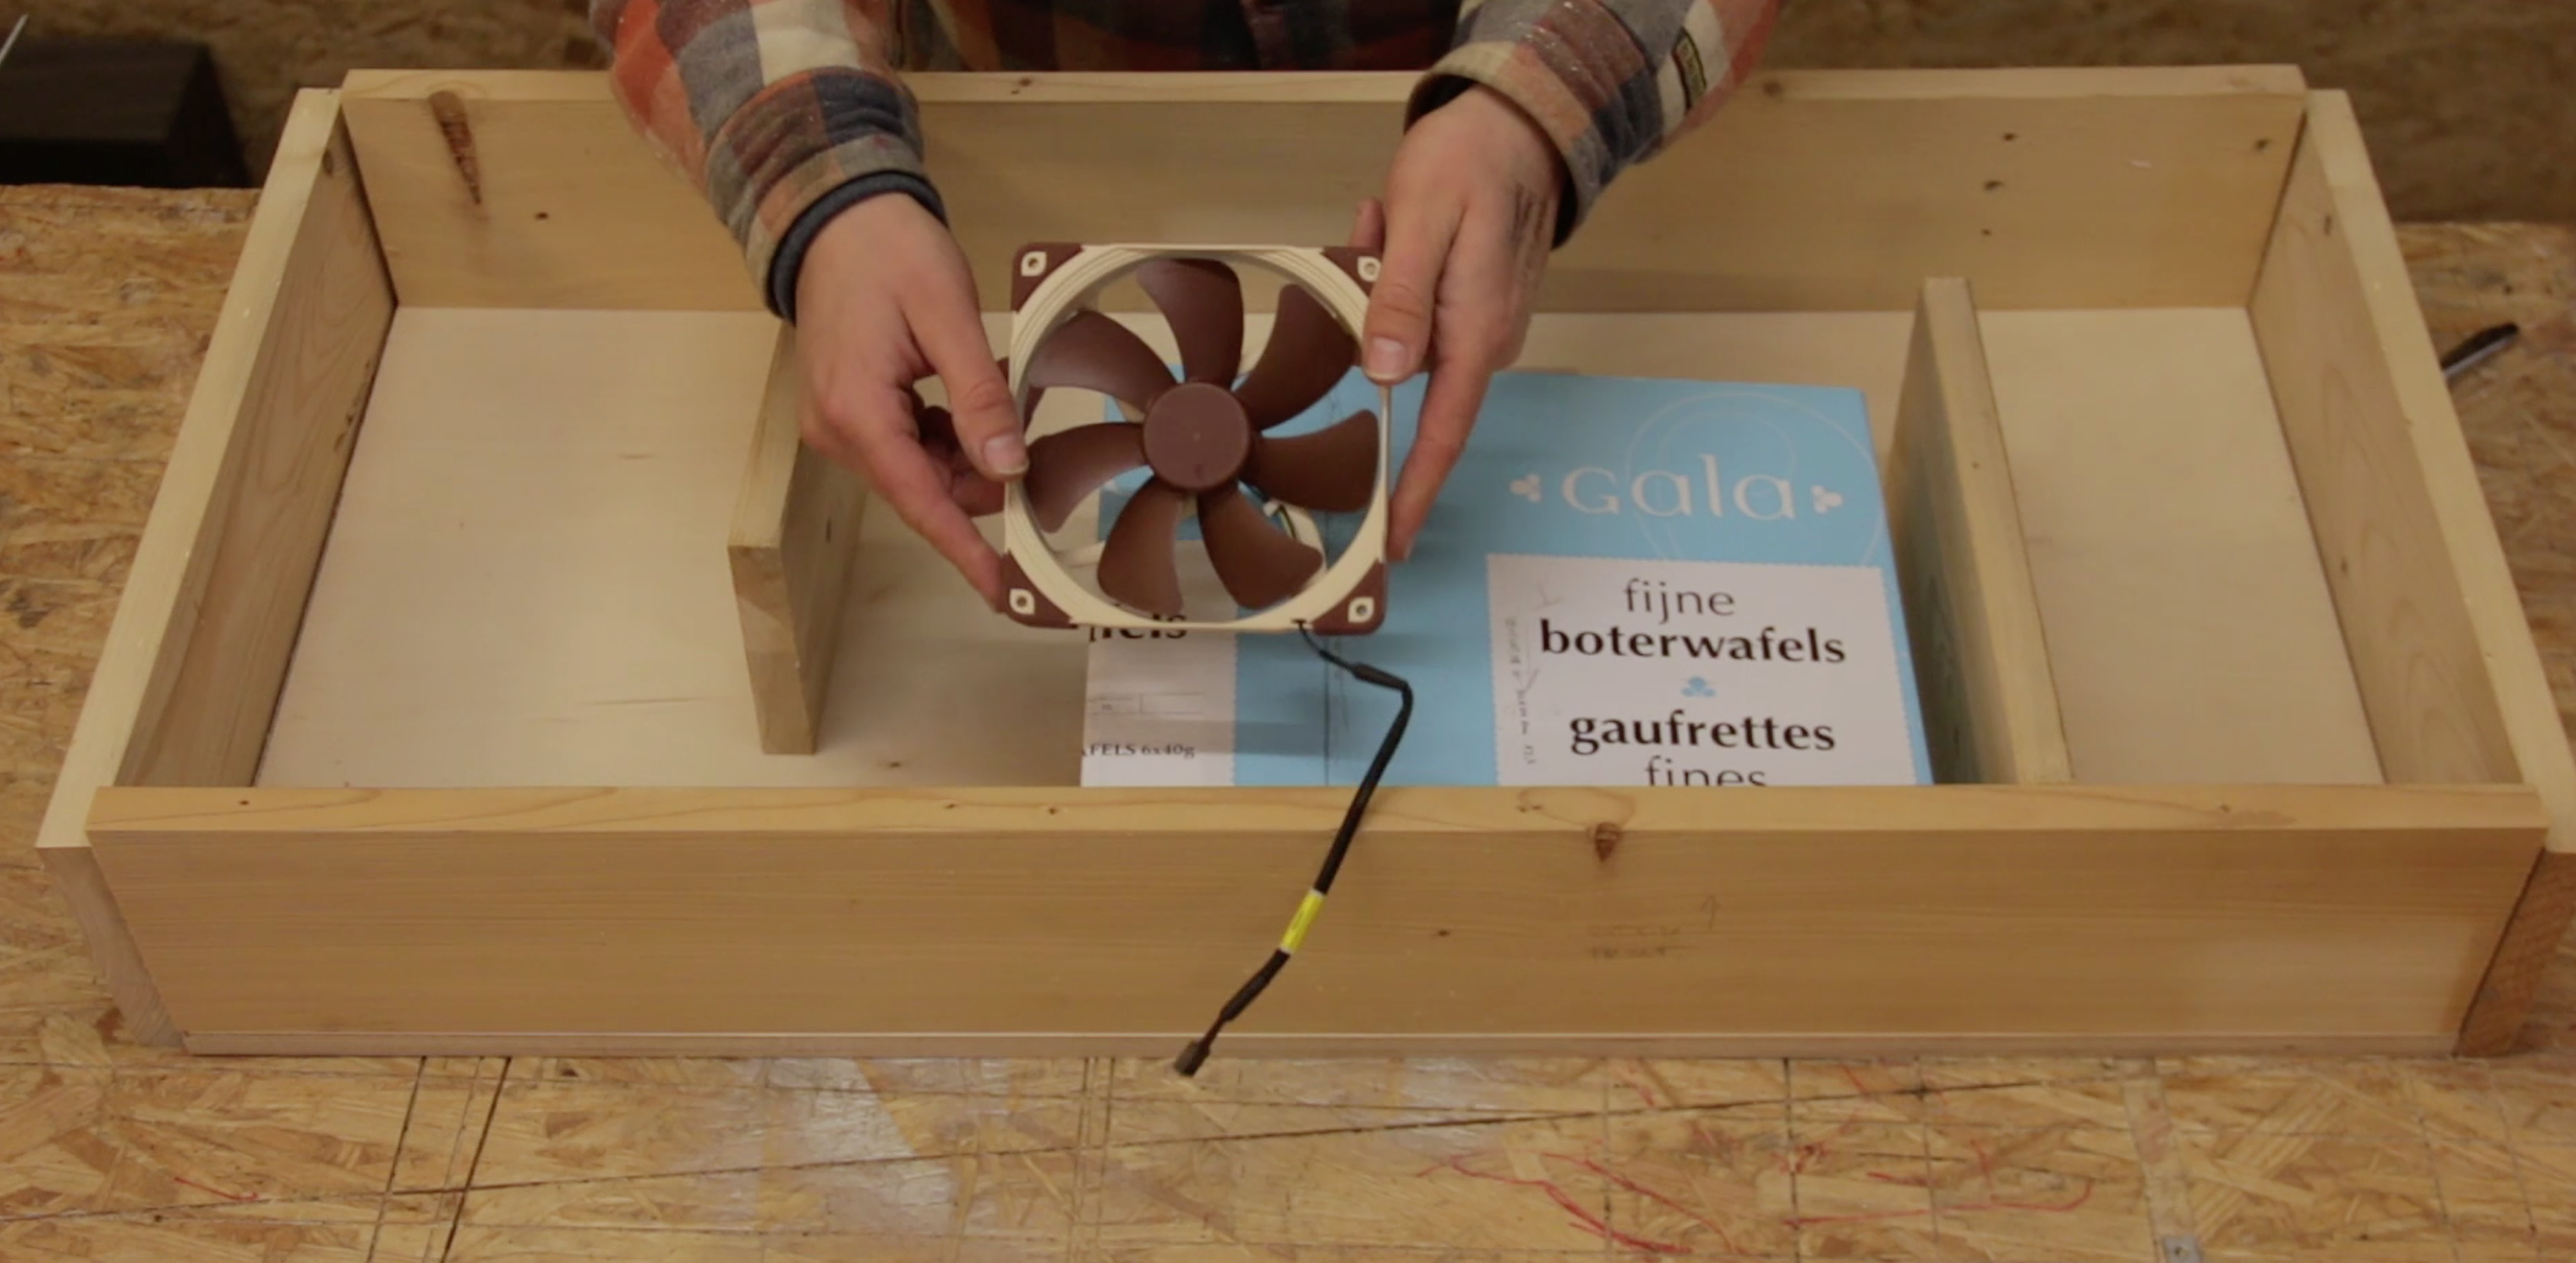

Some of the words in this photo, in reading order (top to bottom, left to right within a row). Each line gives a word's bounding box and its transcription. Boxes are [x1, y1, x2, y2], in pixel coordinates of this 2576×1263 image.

[1623, 578, 1735, 625] fijne
[1540, 619, 1846, 663] boterwafels
[1569, 709, 1836, 755] gaufrettes
